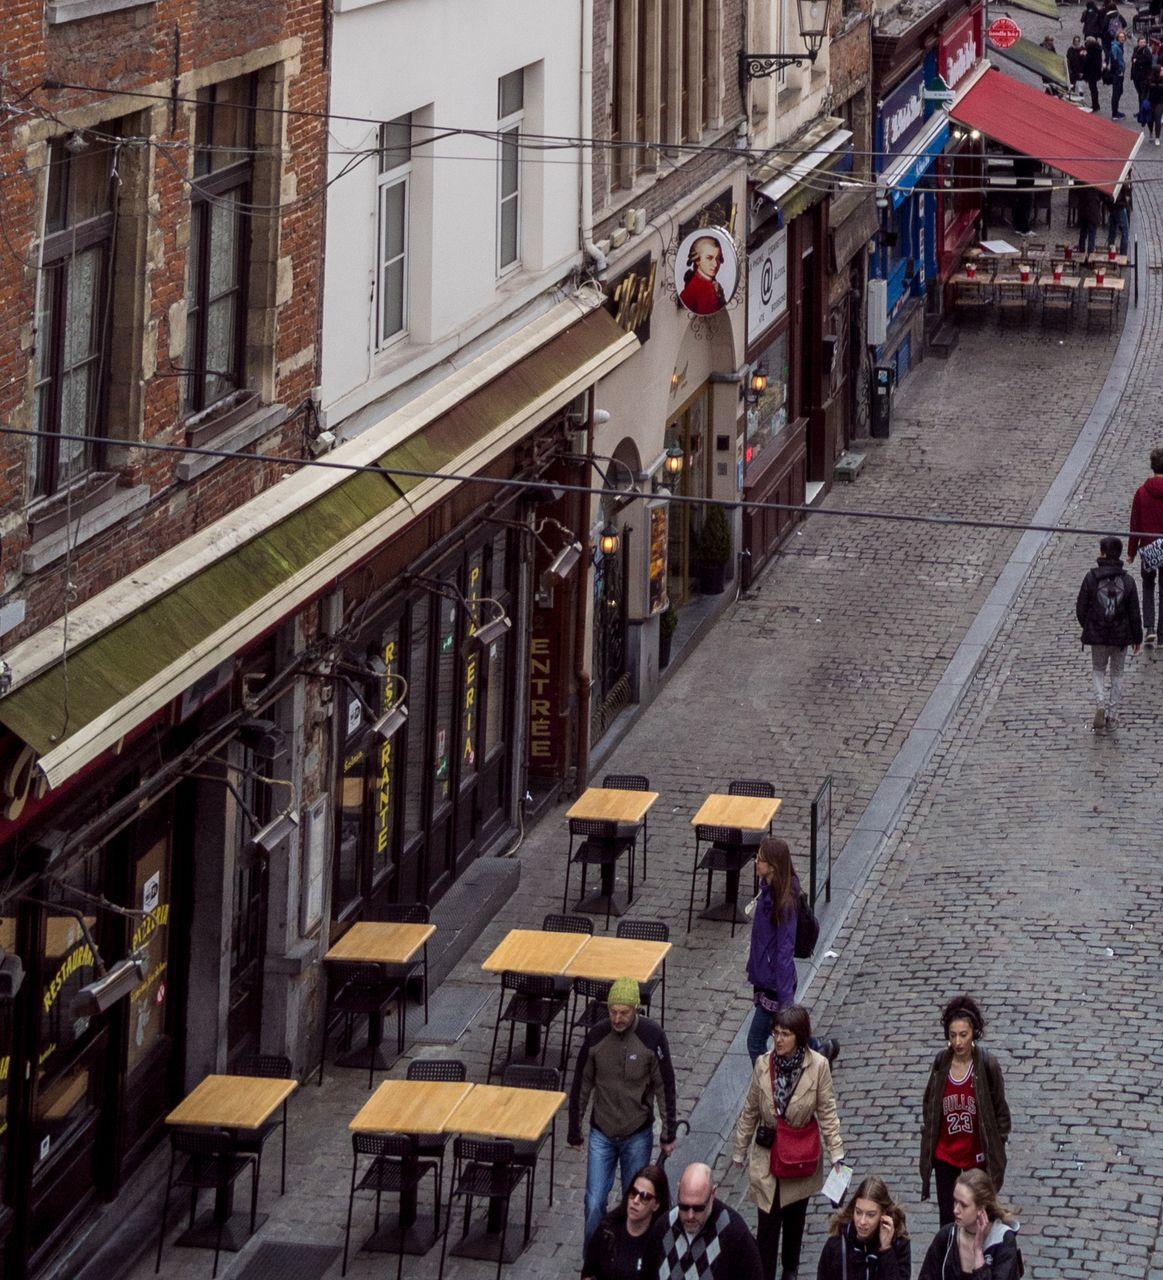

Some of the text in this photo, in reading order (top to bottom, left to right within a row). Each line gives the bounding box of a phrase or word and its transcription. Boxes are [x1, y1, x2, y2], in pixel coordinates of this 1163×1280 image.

[464, 567, 480, 759] PIERIA
[377, 642, 395, 853] RISRANTE
[942, 1093, 977, 1116] BULLS
[946, 1111, 974, 1135] 23
